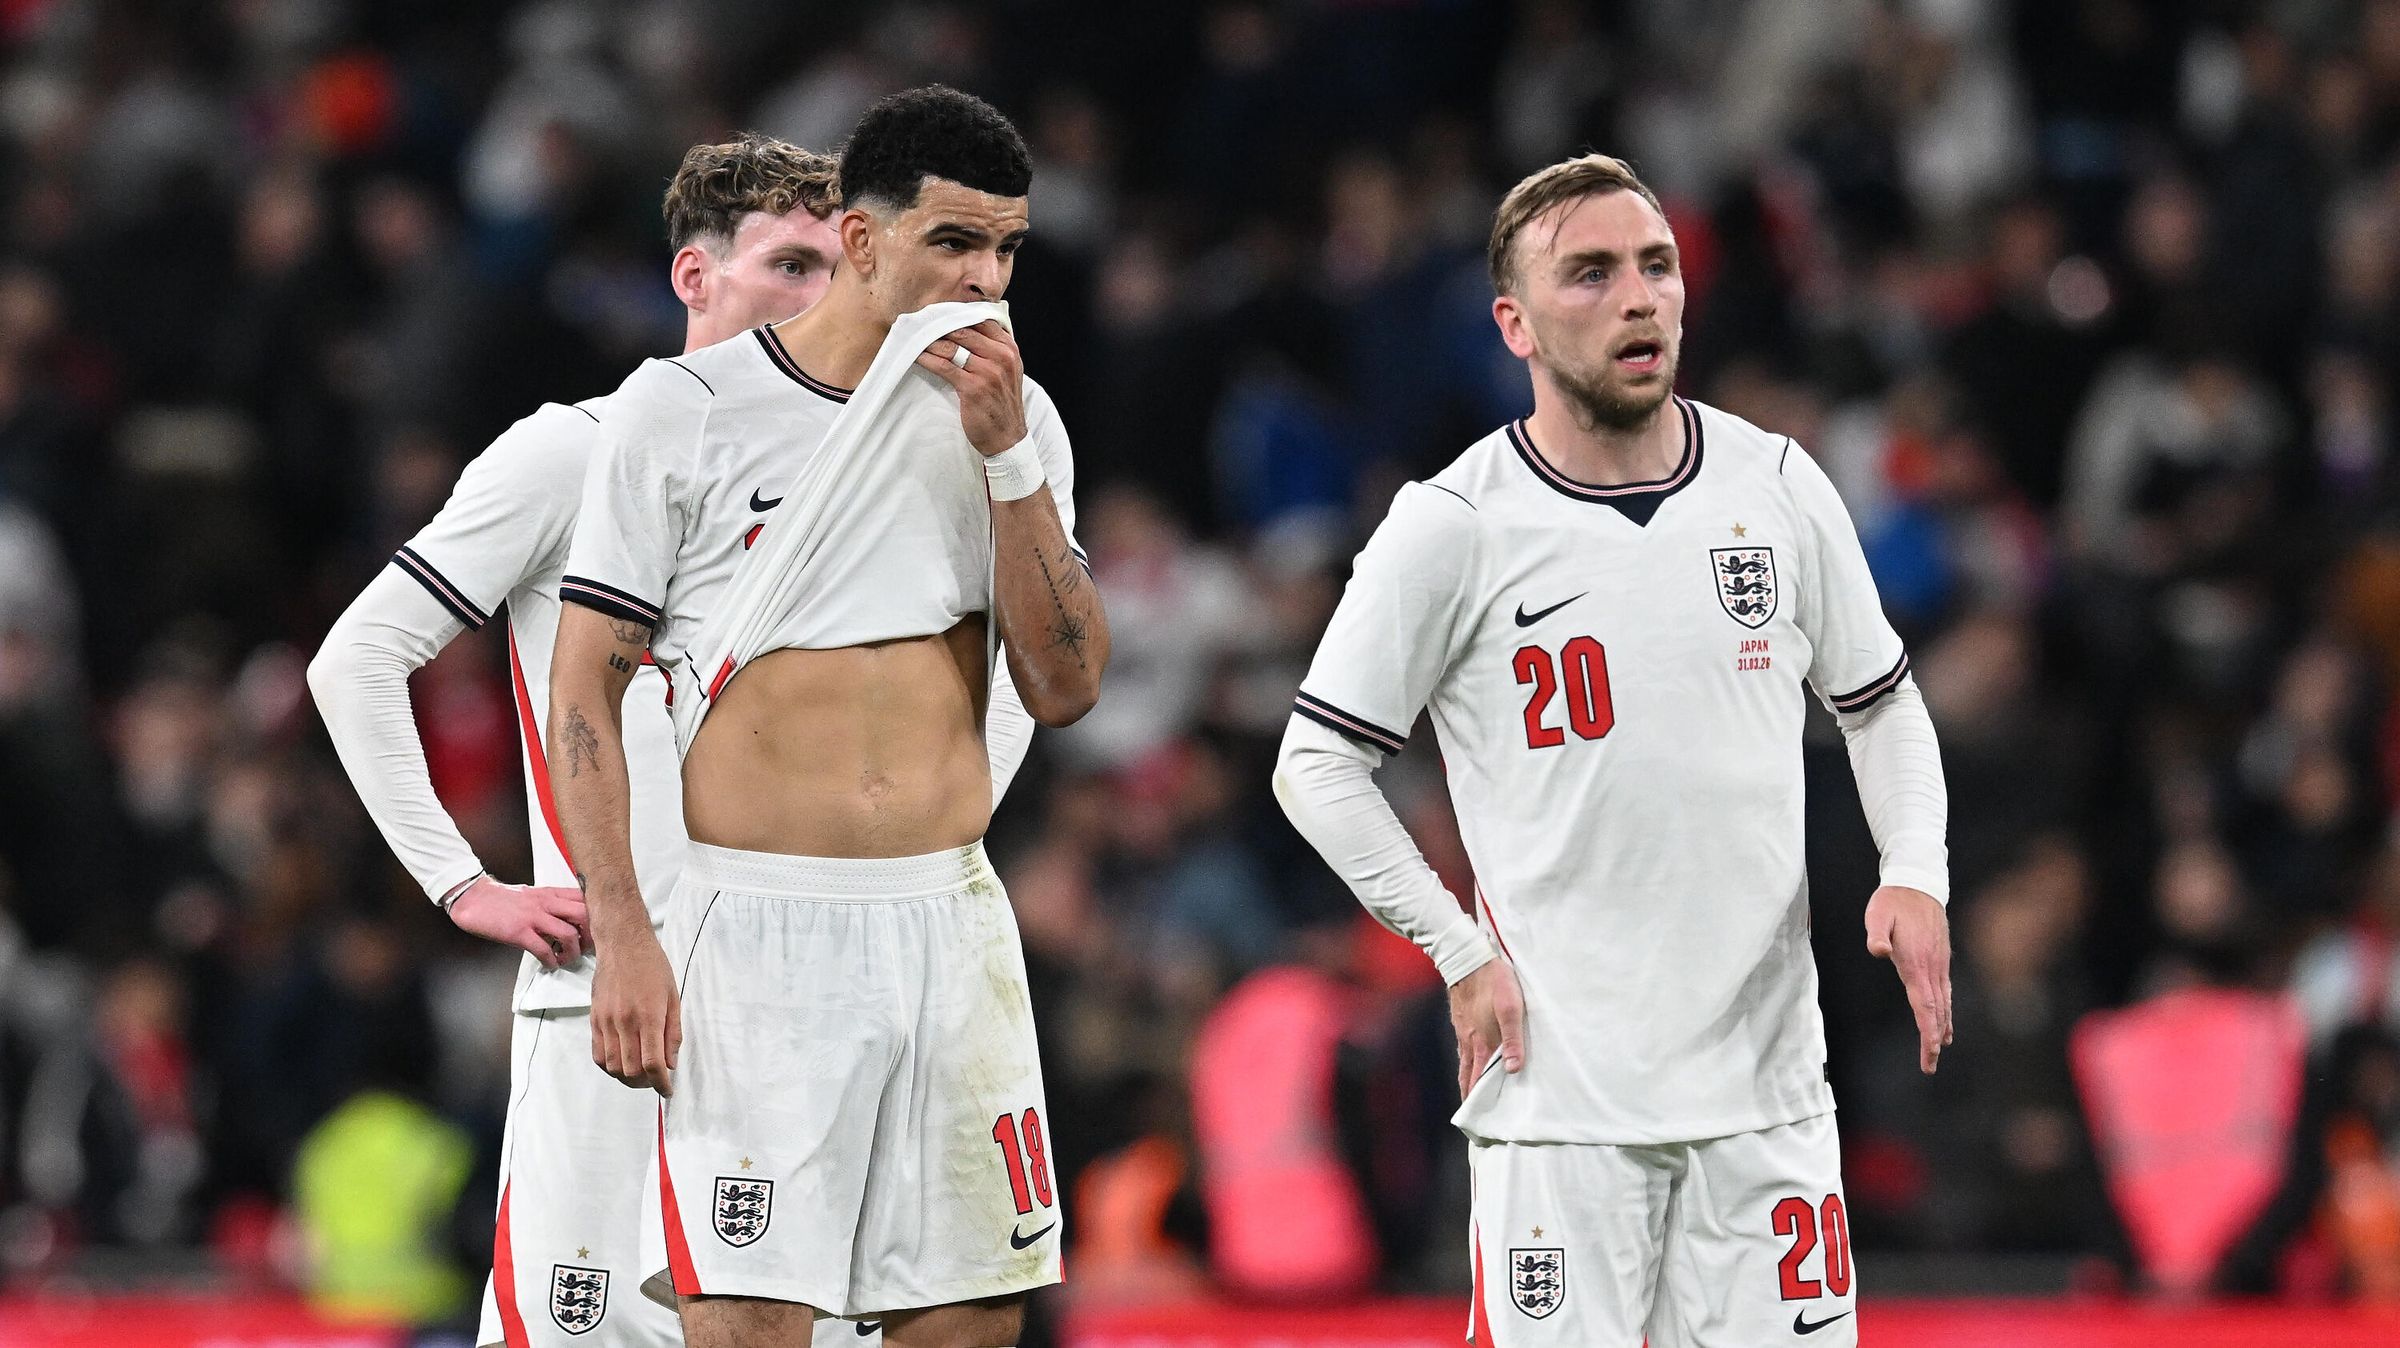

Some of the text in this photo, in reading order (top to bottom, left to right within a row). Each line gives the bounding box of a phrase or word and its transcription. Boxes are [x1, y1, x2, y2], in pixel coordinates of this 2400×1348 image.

[609, 652, 631, 673] LEO
[1512, 635, 1615, 750] 20
[1739, 639, 1769, 654] JAPAN
[992, 1106, 1052, 1215] 18
[1771, 1193, 1850, 1301] 20
